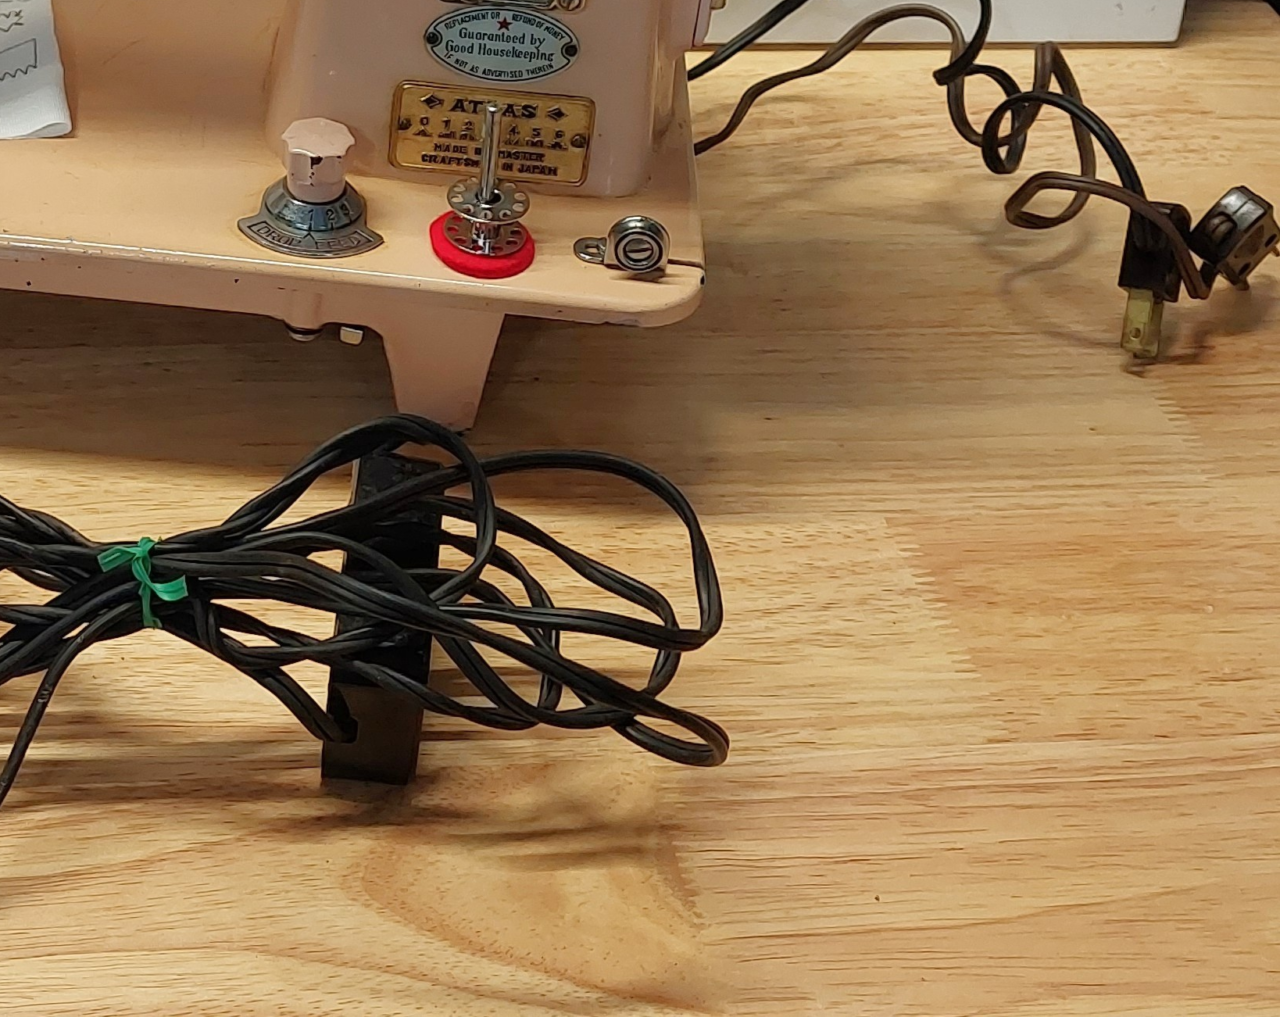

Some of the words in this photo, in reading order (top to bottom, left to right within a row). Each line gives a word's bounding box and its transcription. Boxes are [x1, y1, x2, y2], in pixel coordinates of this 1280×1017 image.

[490, 11, 501, 20] OR
[535, 20, 545, 28] OF
[459, 27, 526, 45] Guaranteed
[530, 34, 546, 49] by
[445, 40, 474, 55] Good
[477, 43, 555, 63] Housekeeping
[443, 51, 452, 60] IF
[454, 58, 468, 69] NOT
[469, 63, 480, 74] AS
[481, 67, 524, 79] ADVERTISED
[526, 62, 554, 77] THEREIN
[449, 98, 538, 120] ATAS
[421, 116, 430, 126] 0
[532, 127, 542, 138] 5
[554, 130, 565, 140] 6
[433, 143, 468, 155] MADE
[498, 150, 546, 164] MASTER
[502, 163, 514, 173] IN
[517, 163, 559, 177] JAPAN
[325, 208, 336, 221] 2
[256, 226, 303, 247] DROP
